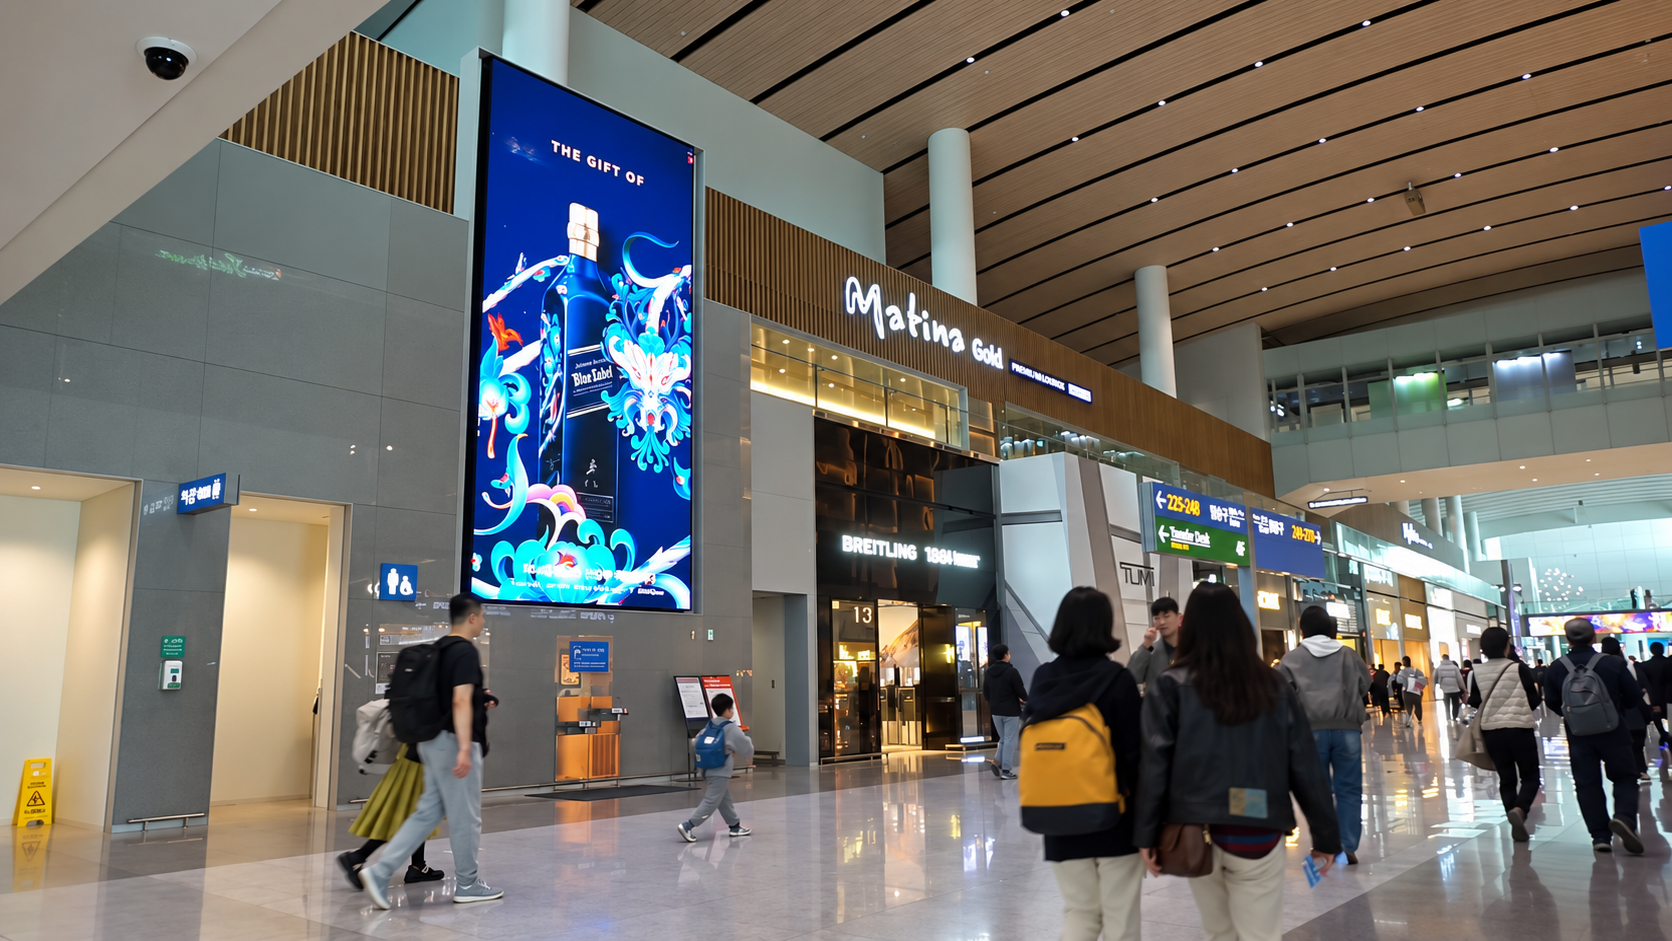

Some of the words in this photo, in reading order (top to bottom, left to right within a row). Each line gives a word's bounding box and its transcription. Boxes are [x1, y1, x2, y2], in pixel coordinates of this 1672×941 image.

[550, 139, 581, 163] THE
[586, 154, 621, 178] GIFT
[625, 170, 645, 187] OF
[845, 276, 965, 352] Matina
[971, 337, 1004, 370] Gold
[1166, 493, 1201, 517] 225-248
[842, 534, 918, 561] BREITLING
[924, 545, 953, 565] 1884
[1119, 565, 1155, 587] TUMI
[853, 606, 873, 624] 13
